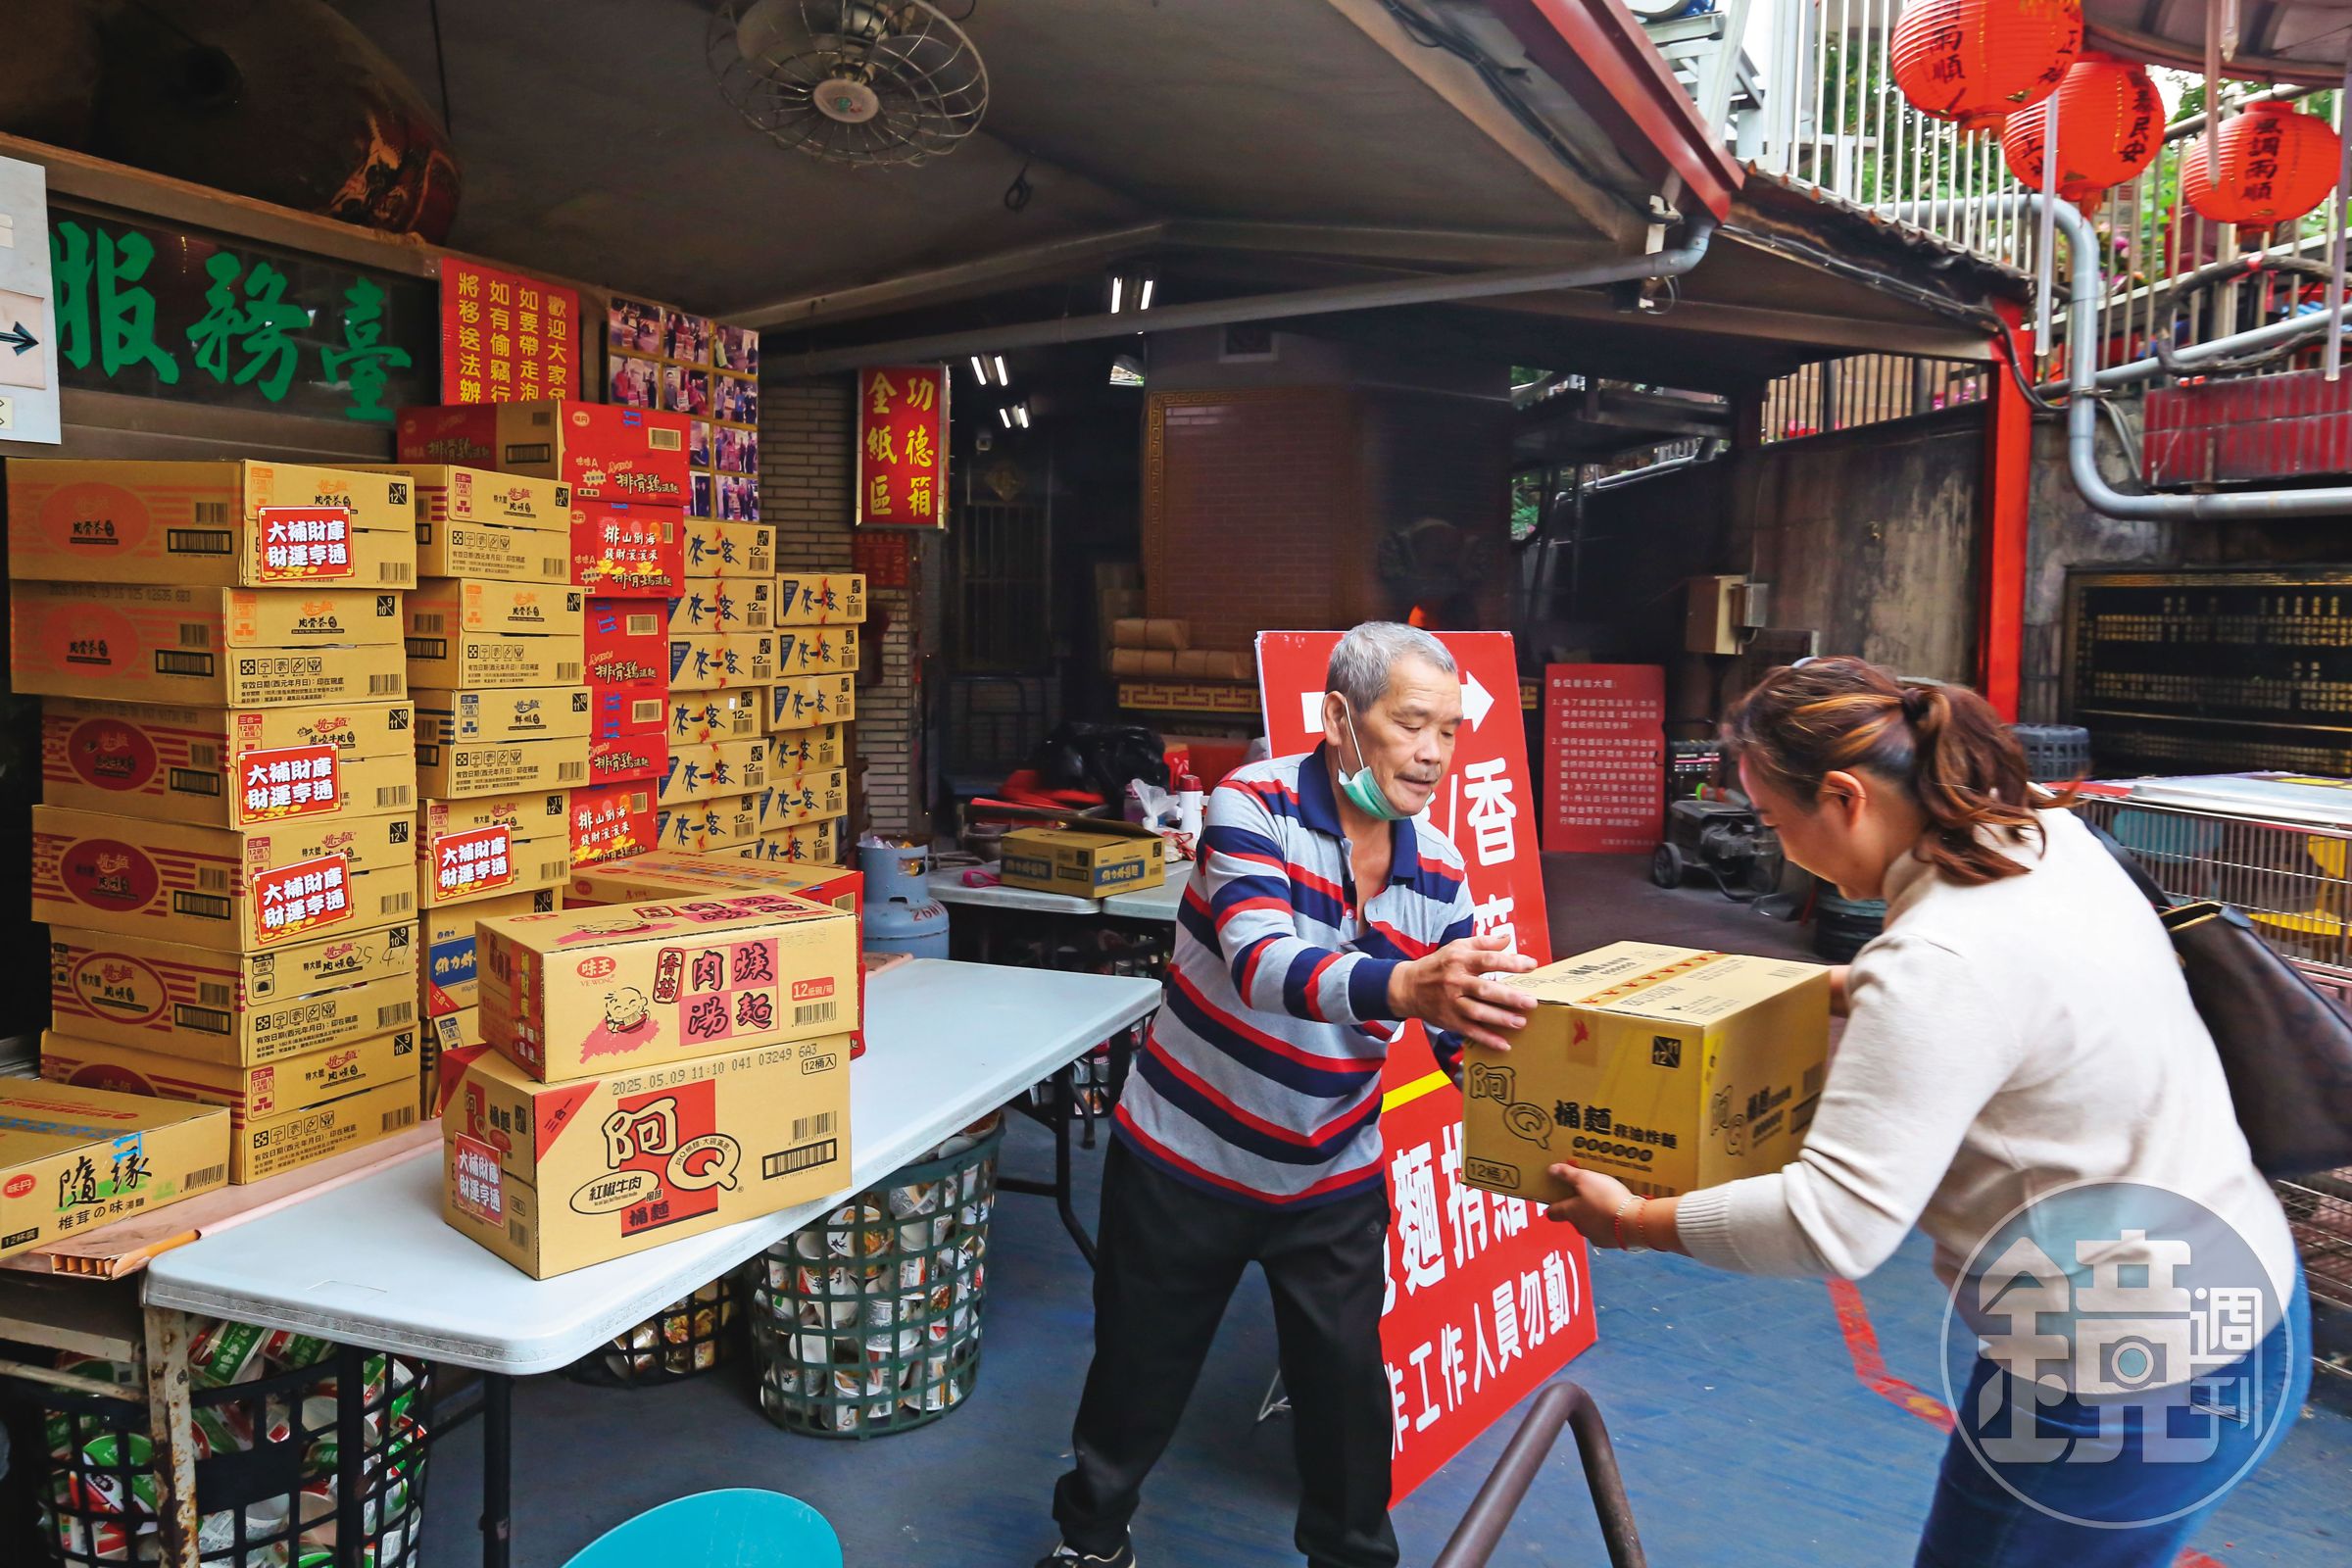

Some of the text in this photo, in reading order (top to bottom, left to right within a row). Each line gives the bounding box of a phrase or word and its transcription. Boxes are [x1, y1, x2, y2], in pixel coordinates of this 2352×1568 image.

[2244, 118, 2282, 202] 風調雨順
[49, 220, 413, 422] 服務臺
[459, 271, 481, 404] 將移送法辦
[866, 371, 898, 516] 金紙區
[906, 376, 934, 517] 功德箱
[268, 520, 345, 543] 大補財庫
[604, 524, 657, 547] 排山倒海
[268, 543, 347, 567] 財運亨通
[688, 533, 740, 566] 來一客
[687, 593, 739, 625] 來一客
[800, 586, 841, 615] 來一客
[298, 616, 327, 628] 肉骨茶
[693, 647, 744, 680] 來一客
[798, 639, 836, 669] 來一客
[673, 703, 726, 736] 來一客
[792, 689, 831, 719] 來一客
[777, 738, 814, 768] 來一客
[247, 757, 332, 786] 大補財庫
[682, 759, 735, 794] 來一客
[247, 779, 334, 809] 財運亨通
[776, 787, 820, 819] 來一客
[578, 805, 627, 831] 排山倒海
[673, 810, 726, 846] 來一客
[442, 836, 507, 867] 大補財庫
[263, 866, 343, 906] 大補財庫
[441, 856, 508, 887] 財運亨通
[264, 889, 346, 929] 財運亨通
[434, 949, 477, 976] 維力炸
[581, 958, 612, 976] 味王
[656, 953, 682, 1000] 香菇
[432, 990, 451, 1008] 三合一
[688, 992, 772, 1038] 湯麵
[252, 1070, 274, 1079] 三合一
[612, 1043, 818, 1096] 2025.05.09 11:10 041 03249 6A3
[804, 1055, 835, 1072] 12桶入
[543, 1098, 573, 1133] 三合一
[1469, 1061, 1553, 1151] 阿Q
[1553, 1099, 1612, 1136] 桶麵
[601, 1096, 742, 1192] 阿Q
[459, 1148, 500, 1186] 大補財庫
[459, 1175, 501, 1214] 財運亨通
[589, 1175, 642, 1202] 紅椒牛肉
[629, 1200, 670, 1227] 桶麵
